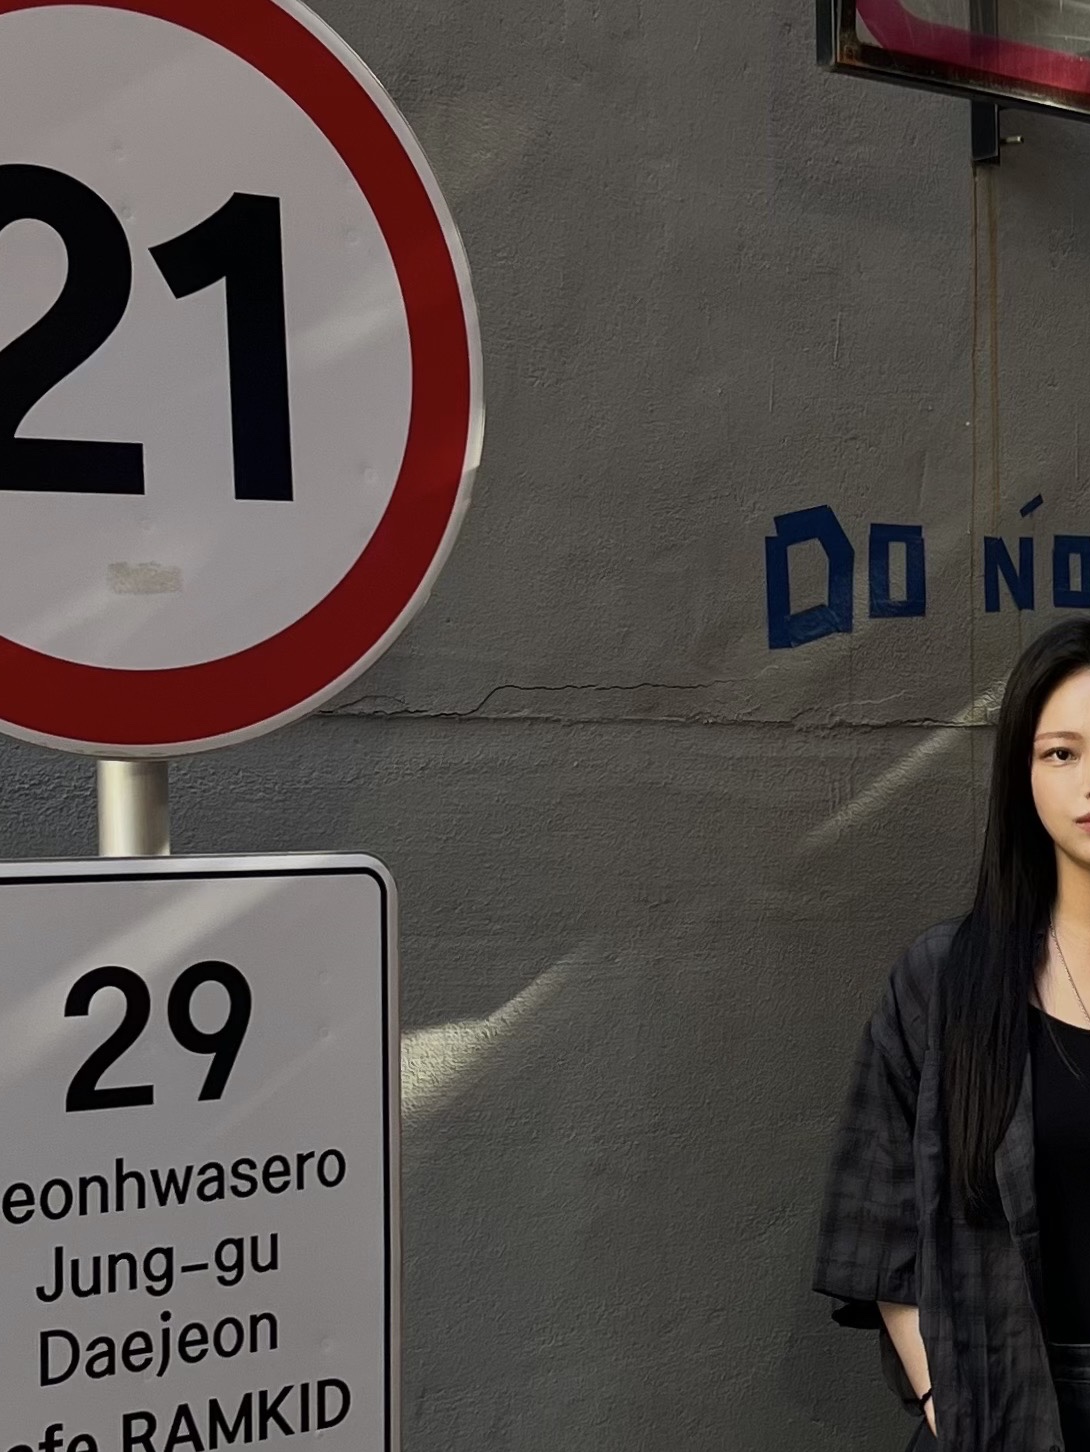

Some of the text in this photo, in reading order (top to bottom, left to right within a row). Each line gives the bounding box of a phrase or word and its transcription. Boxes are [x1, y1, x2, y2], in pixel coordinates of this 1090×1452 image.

[0, 163, 294, 502] 21
[63, 960, 253, 1113] 29
[35, 1231, 280, 1303] Jung-gu
[39, 1310, 279, 1387] Daejeon
